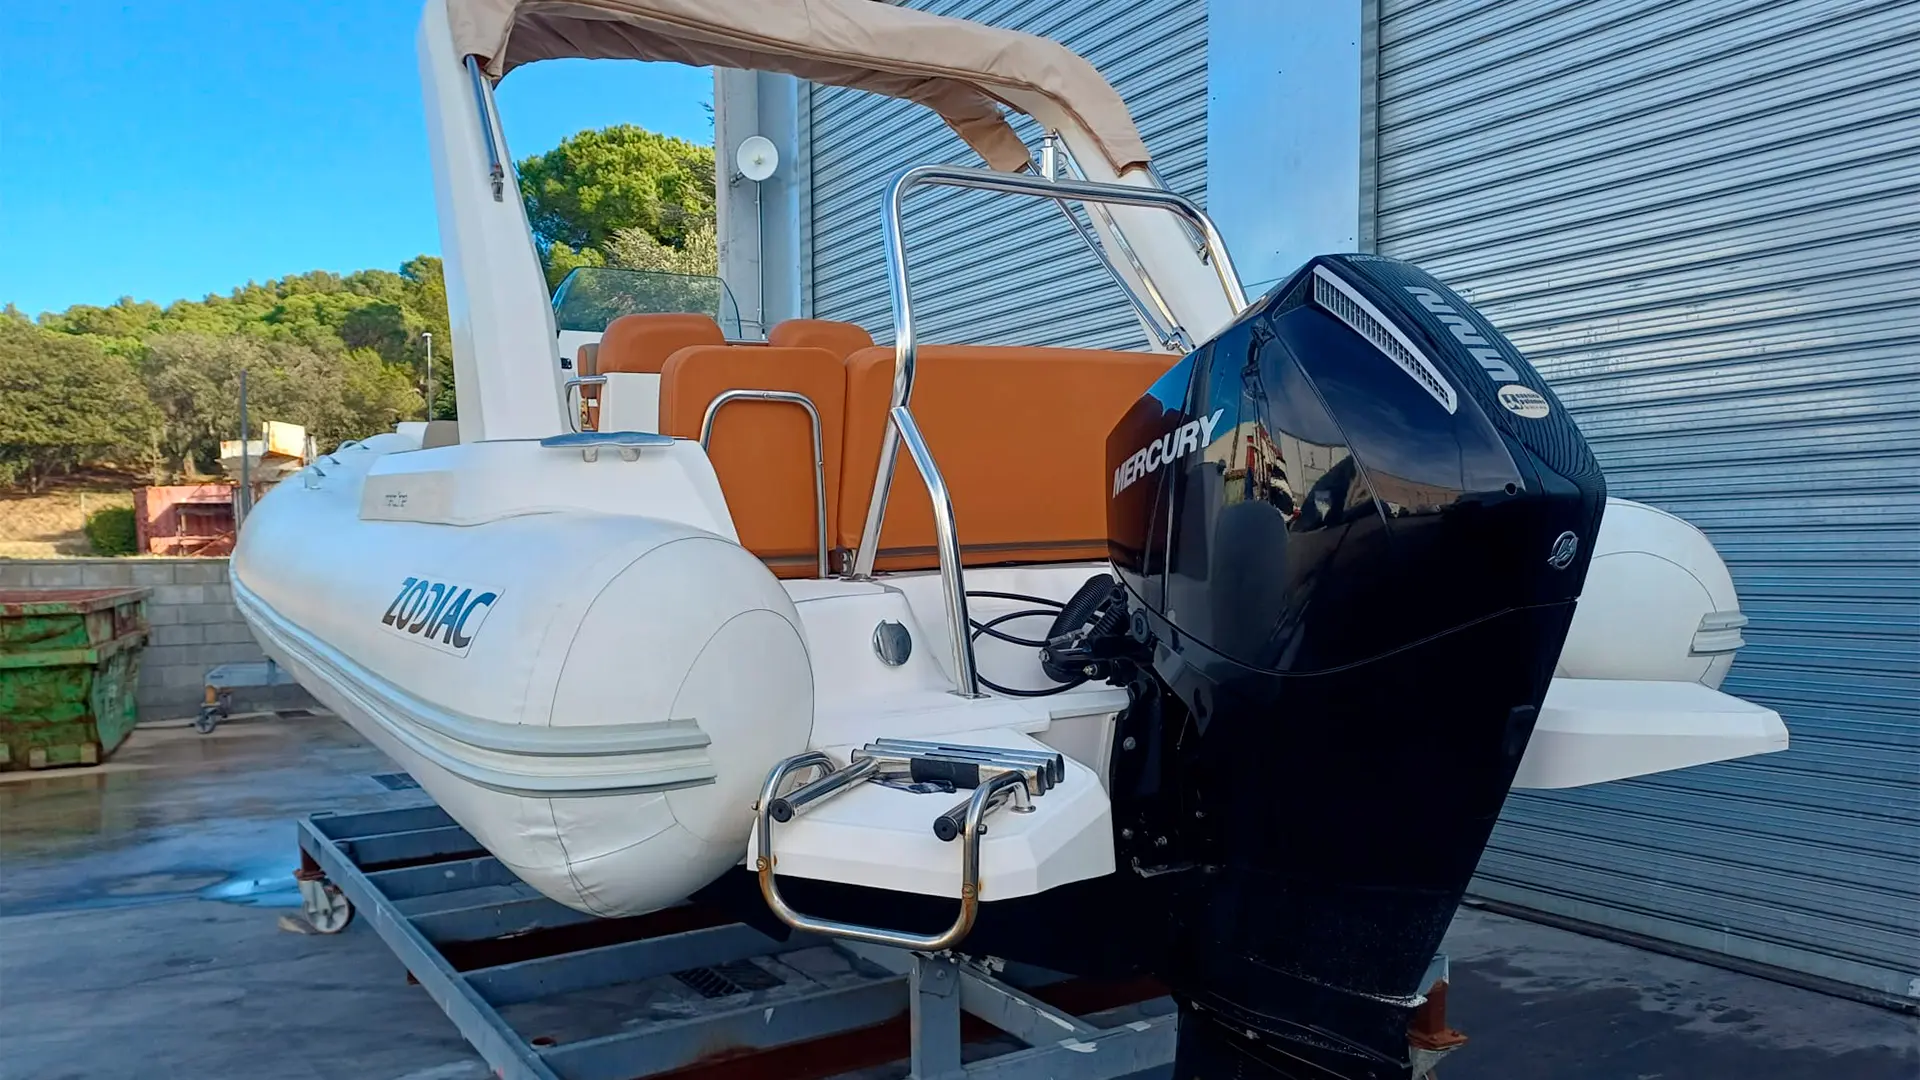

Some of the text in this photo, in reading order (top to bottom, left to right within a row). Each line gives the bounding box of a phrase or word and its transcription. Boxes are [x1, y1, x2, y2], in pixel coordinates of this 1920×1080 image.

[1402, 286, 1520, 382] 225
[1112, 408, 1225, 499] MERCURY
[381, 577, 497, 649] ZODIAC
